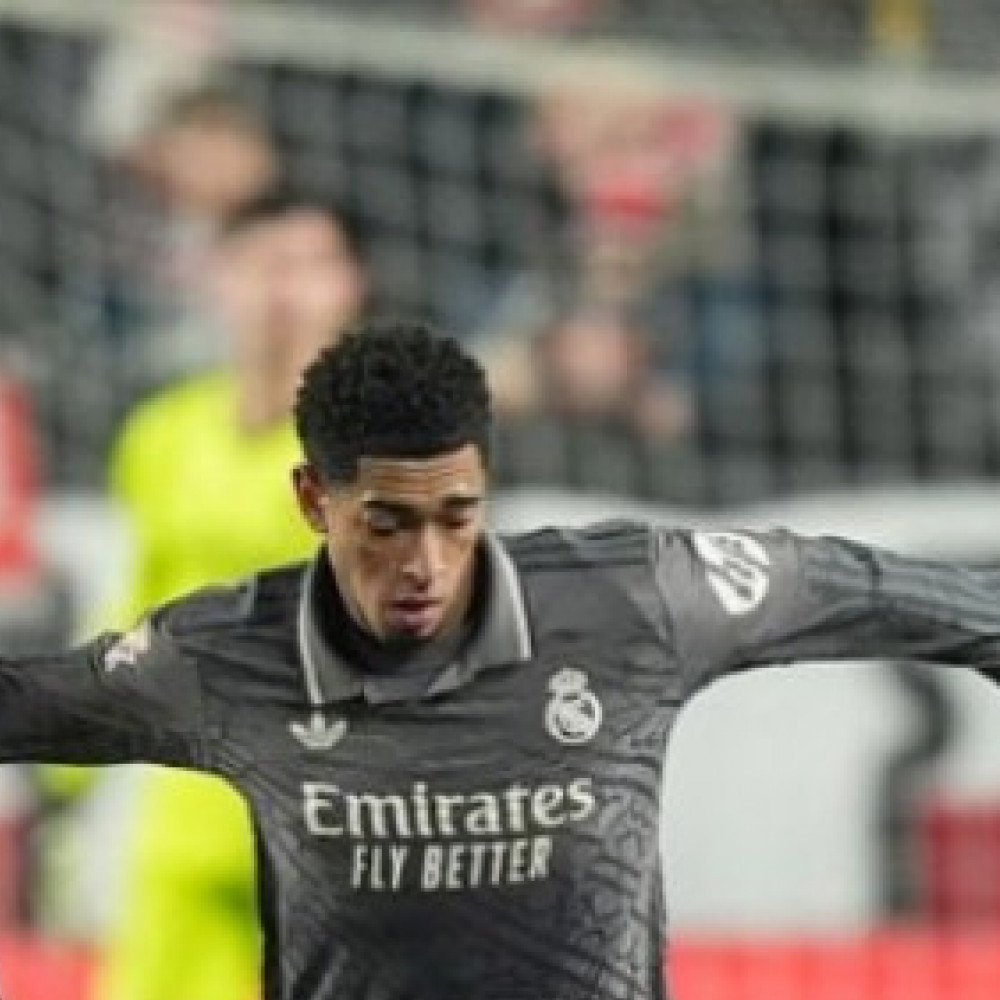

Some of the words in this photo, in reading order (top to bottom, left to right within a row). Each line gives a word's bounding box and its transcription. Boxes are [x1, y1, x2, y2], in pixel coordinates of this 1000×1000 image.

[303, 777, 596, 838] Emirates
[352, 844, 409, 892] FLY
[421, 836, 554, 892] BETTER
